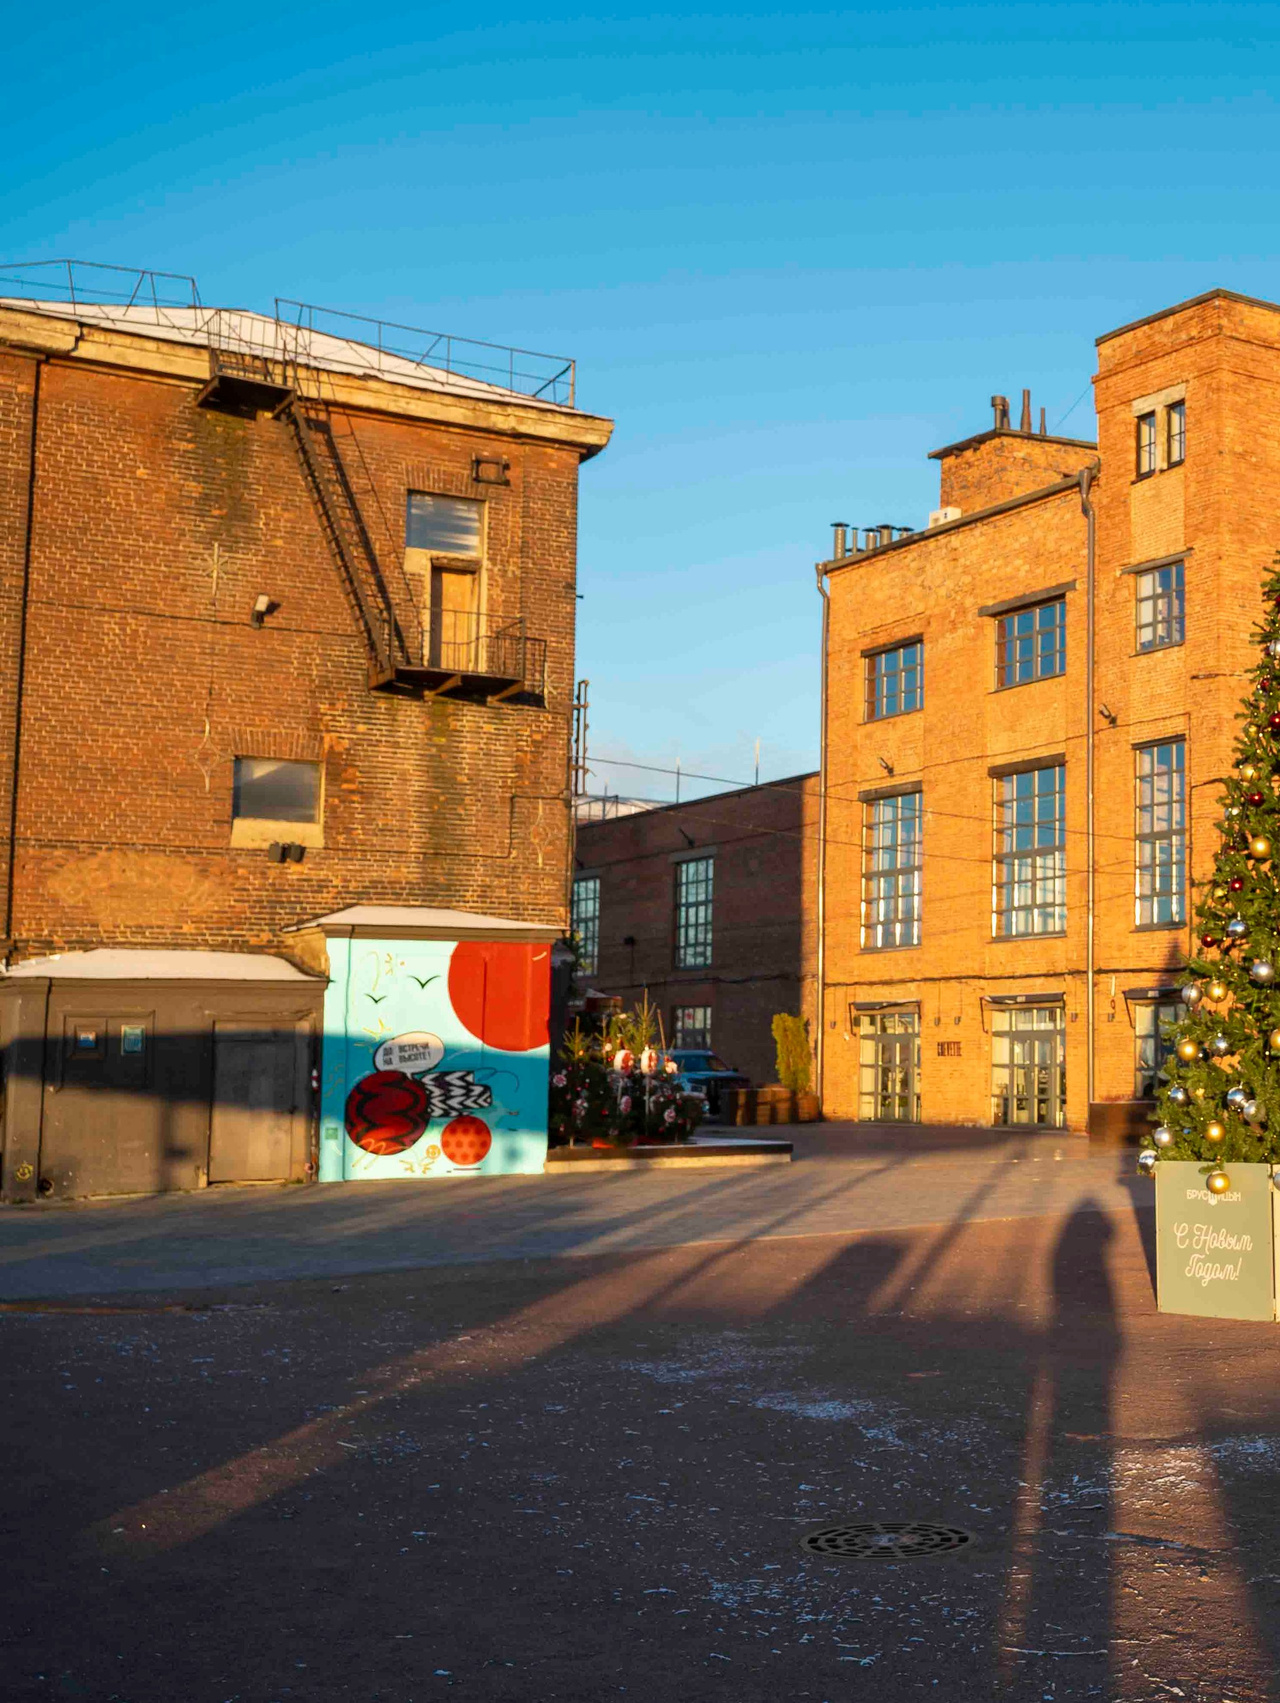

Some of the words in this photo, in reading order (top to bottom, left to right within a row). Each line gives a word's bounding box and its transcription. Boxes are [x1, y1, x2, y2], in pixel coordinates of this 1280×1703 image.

[1174, 1222, 1189, 1249] С
[1193, 1223, 1253, 1255] Новым
[1185, 1253, 1243, 1287] Годом!
